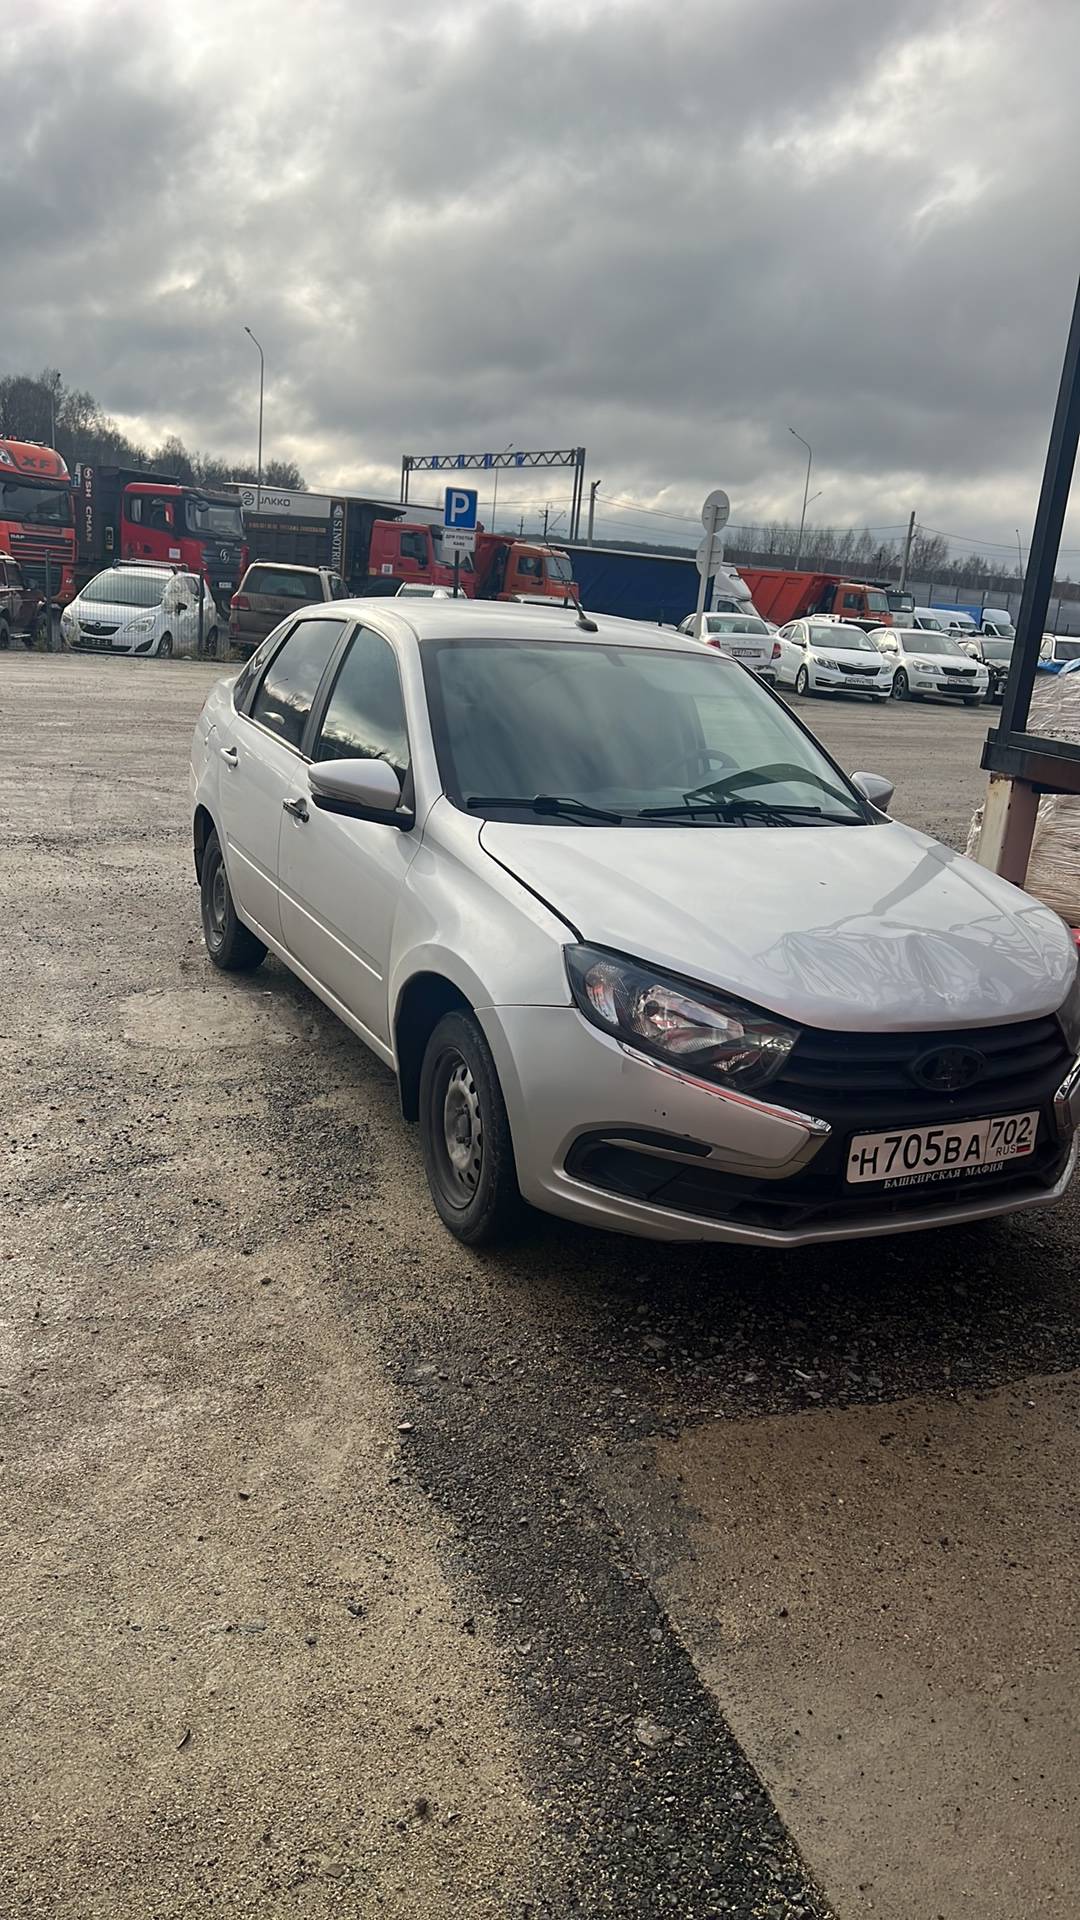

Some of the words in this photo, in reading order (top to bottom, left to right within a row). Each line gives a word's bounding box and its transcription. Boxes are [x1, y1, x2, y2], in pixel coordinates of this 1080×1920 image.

[22, 455, 49, 469] XF
[450, 491, 470, 523] P
[859, 1130, 981, 1176] Н705ВА
[991, 1116, 1031, 1148] 702
[995, 1143, 1017, 1156] RUS
[883, 1169, 961, 1189] БАШКИРСКАЯ
[965, 1161, 1004, 1177] МАФИЯ
